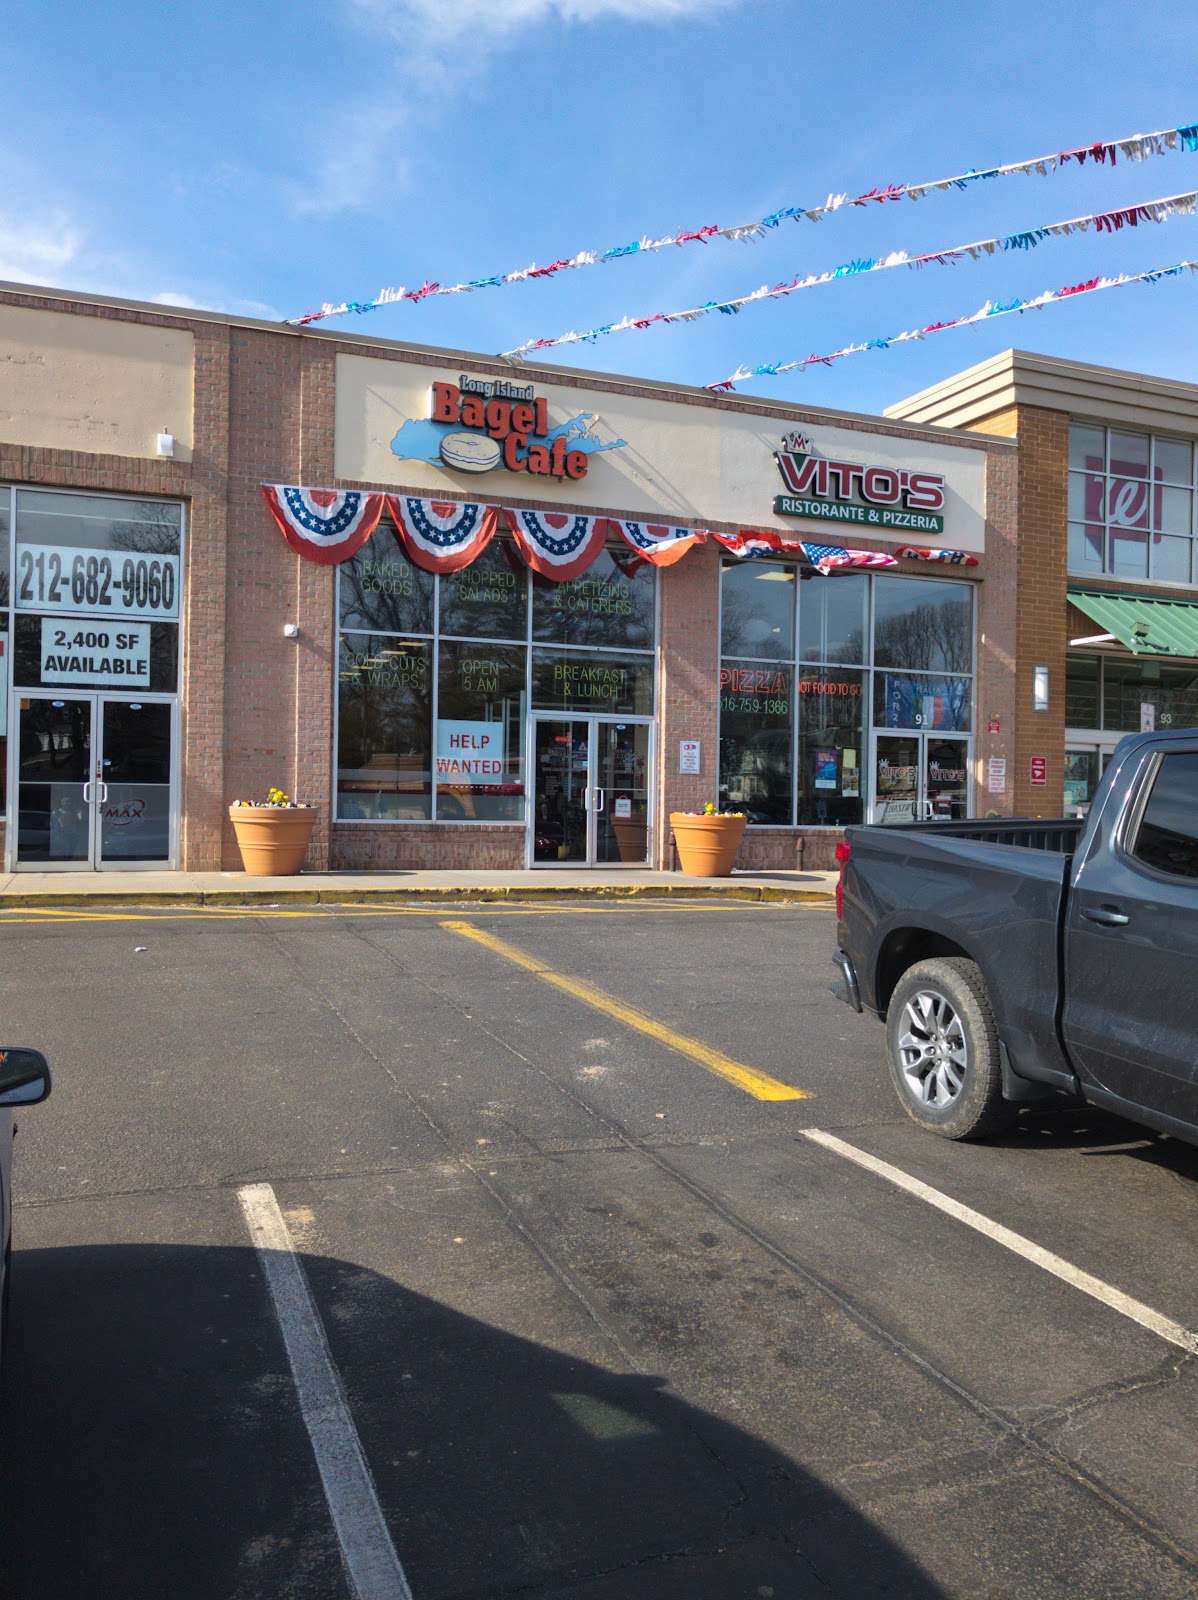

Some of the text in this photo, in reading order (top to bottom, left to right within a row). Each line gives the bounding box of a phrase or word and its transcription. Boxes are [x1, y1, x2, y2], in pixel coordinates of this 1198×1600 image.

[461, 375, 534, 401] Long Island
[431, 381, 548, 440] Bagel
[503, 432, 588, 480] Cafe
[776, 451, 945, 510] VITO'S
[782, 498, 938, 530] RISTORANTE & PIZZERIA
[362, 562, 410, 578] BAKED
[20, 550, 174, 610] 212-682-9060
[360, 578, 412, 596] GOODS
[452, 570, 516, 588] CHOPPED
[459, 586, 508, 603] SALADS
[558, 581, 629, 598] APPETIZING
[554, 597, 632, 615] & CATERERS
[54, 629, 139, 650] 2,400 SF
[44, 655, 148, 676] AVAILABLE
[346, 652, 426, 672] COLD CUTS
[462, 659, 500, 675] OPEN
[350, 672, 419, 689] & WRAPS
[554, 666, 626, 683] BREAKFAST
[720, 668, 787, 694] PIZZA
[464, 676, 497, 691] 5 AM
[564, 683, 618, 698] & LUNCH
[799, 682, 862, 696] OT FOOD TO GO
[892, 681, 901, 728] FORZ
[915, 714, 928, 726] 91
[1160, 714, 1172, 724] 93
[450, 734, 490, 749] HELP
[436, 758, 502, 774] WANTED
[930, 768, 965, 780] VITO'S
[105, 808, 142, 818] MAX
